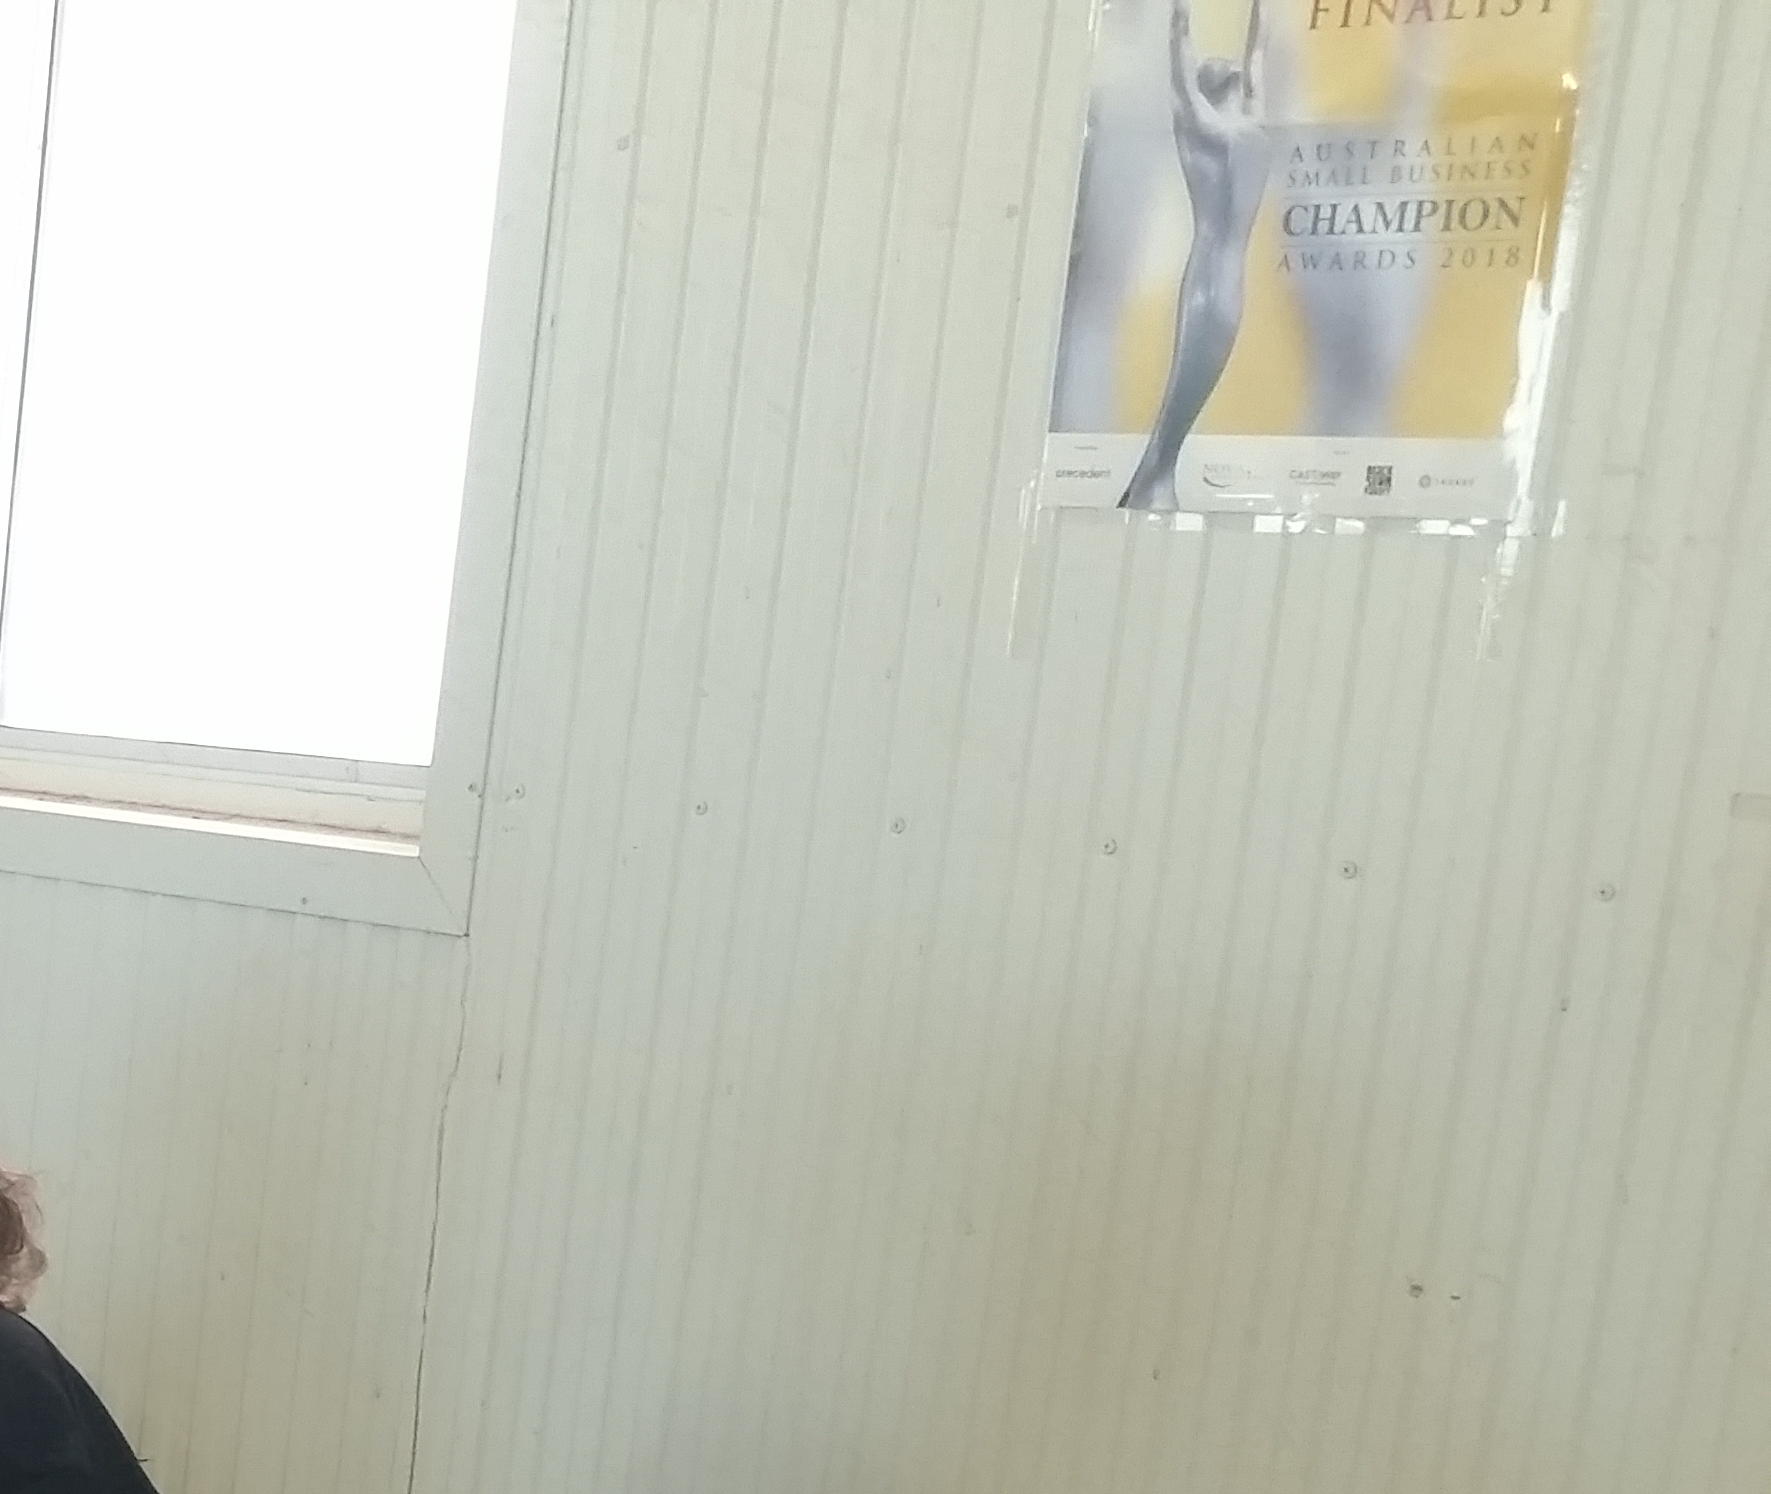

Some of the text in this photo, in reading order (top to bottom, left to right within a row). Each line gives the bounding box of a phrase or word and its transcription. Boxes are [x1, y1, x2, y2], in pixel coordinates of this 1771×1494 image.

[1308, 0, 1553, 30] FINAL
[1290, 133, 1538, 164] AUSTRALIAN
[1288, 160, 1531, 187] SMALL BUSINESS
[1283, 197, 1526, 236] CHAMPION
[1277, 247, 1521, 272] AWARDS 2018
